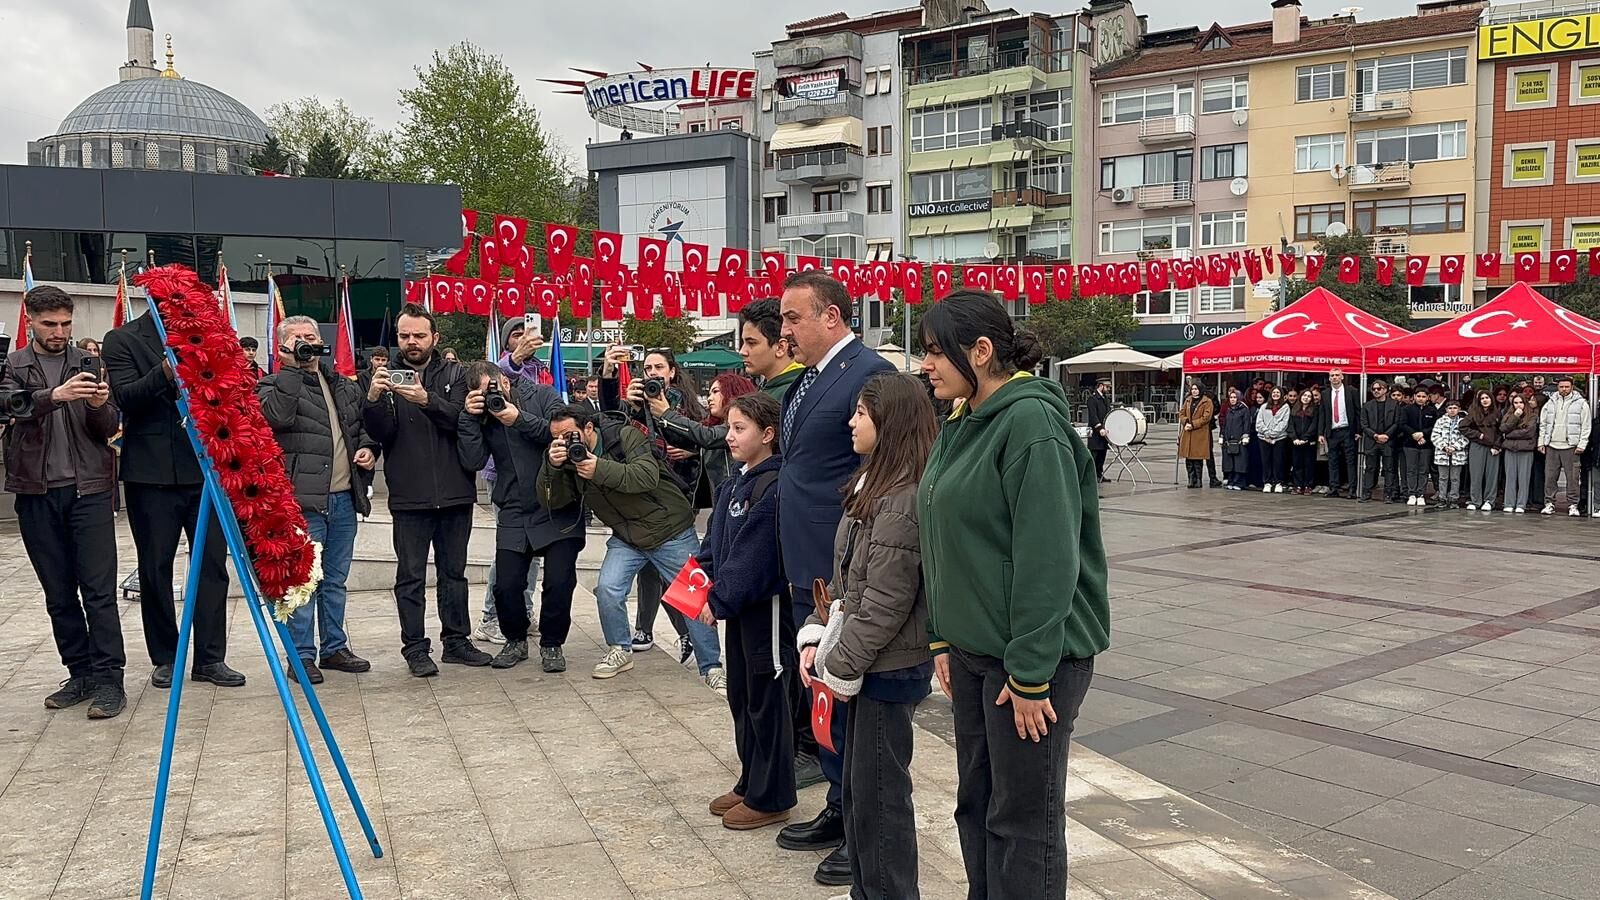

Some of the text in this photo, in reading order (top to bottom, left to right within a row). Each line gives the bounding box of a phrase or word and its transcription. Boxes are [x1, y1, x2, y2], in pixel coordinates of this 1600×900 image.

[1489, 16, 1600, 57] ENGL
[584, 70, 756, 112] American LIFE
[909, 201, 989, 216] UNIQ Art Collective
[1239, 354, 1294, 363] BÜYÜKŞEHİR
[1296, 356, 1350, 365] BELEDİYESİ
[1388, 355, 1578, 364] KOCAELİ BÜYÜKŞEHİR BELEDİYESİ
